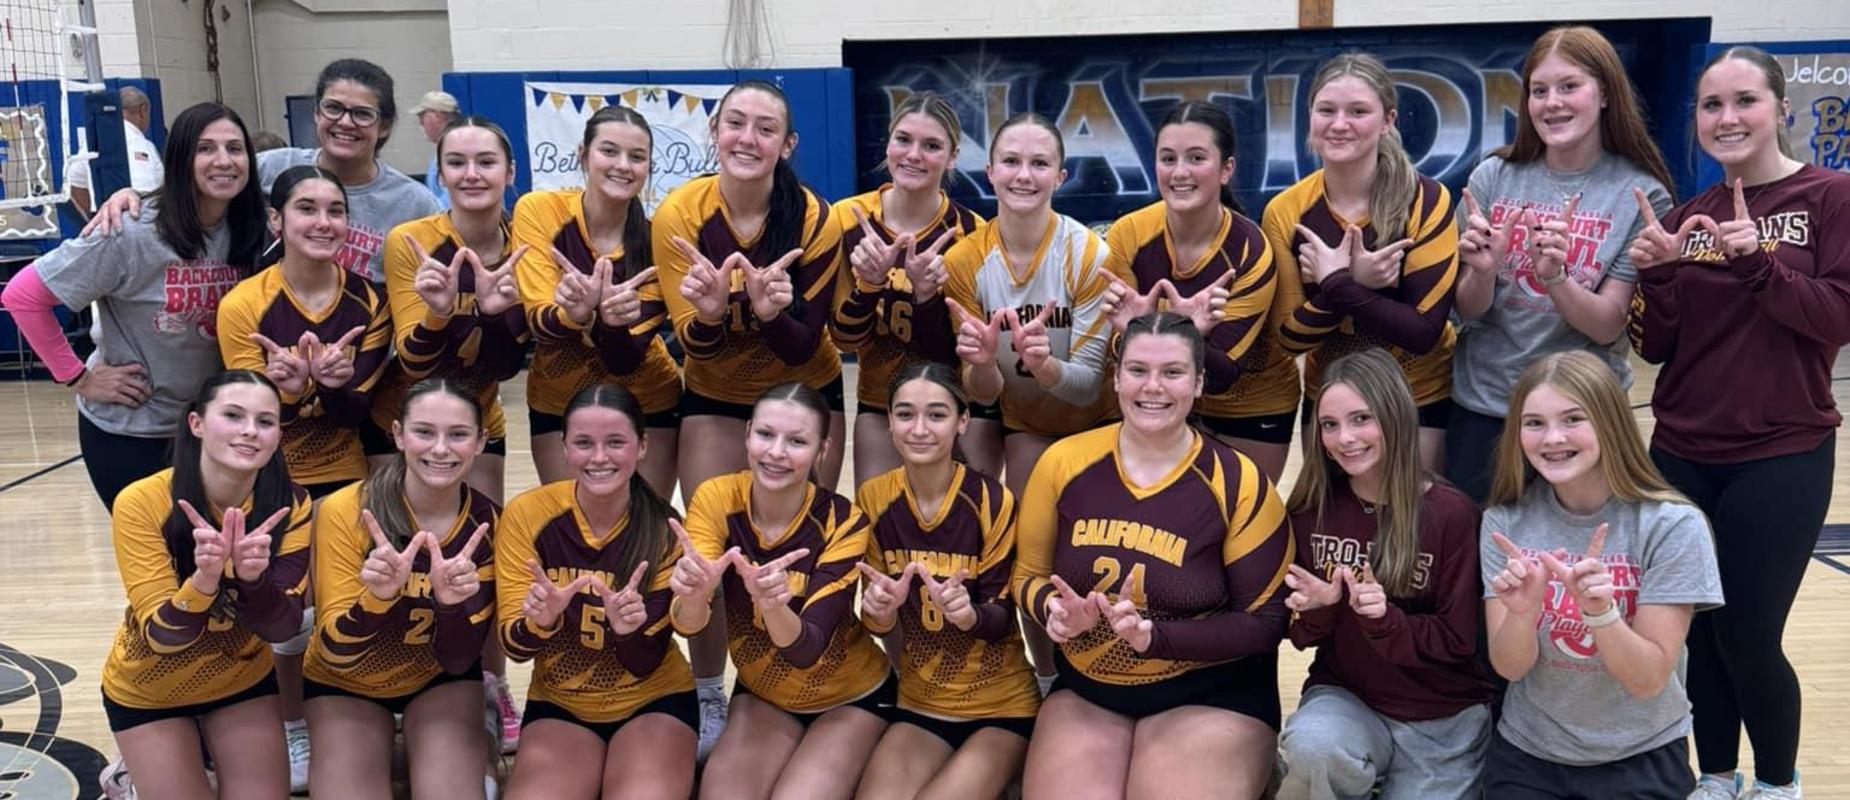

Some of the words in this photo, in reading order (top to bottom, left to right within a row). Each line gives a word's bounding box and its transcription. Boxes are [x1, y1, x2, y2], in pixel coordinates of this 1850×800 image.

[1785, 55, 1850, 85] elco
[1071, 519, 1188, 567] CALIFORNIA
[403, 607, 434, 645] 2
[580, 603, 606, 651] 5
[920, 584, 943, 632] 8
